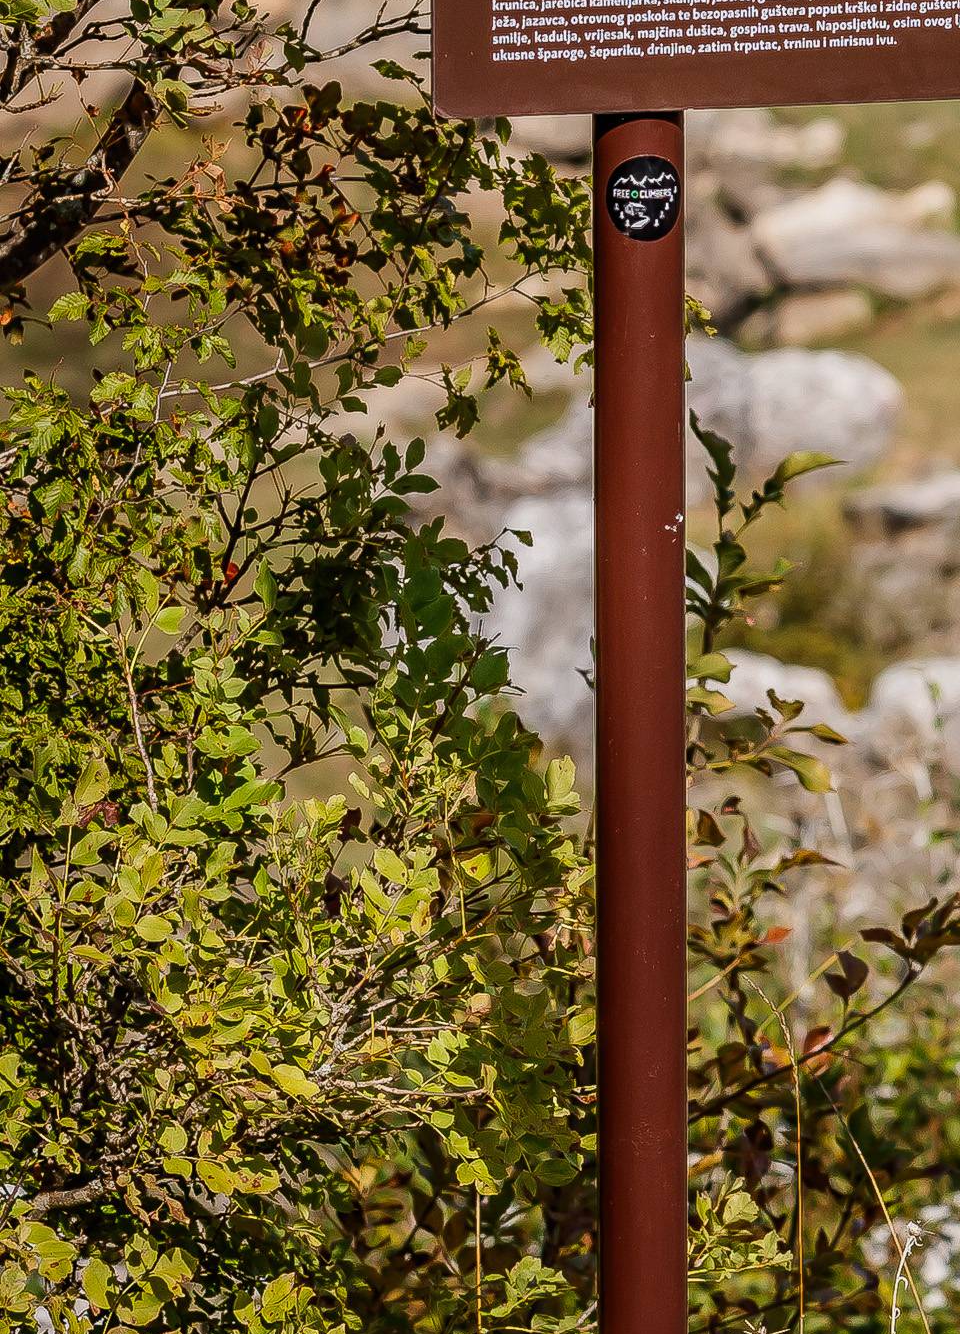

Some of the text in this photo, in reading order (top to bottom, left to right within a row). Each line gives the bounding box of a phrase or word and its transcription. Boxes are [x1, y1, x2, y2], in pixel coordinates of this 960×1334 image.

[492, 34, 897, 62] ukusne šparoge, šepuriku, drinjine, zatim trputac, trninu i mirisnu ivu.
[612, 188, 630, 199] FREE
